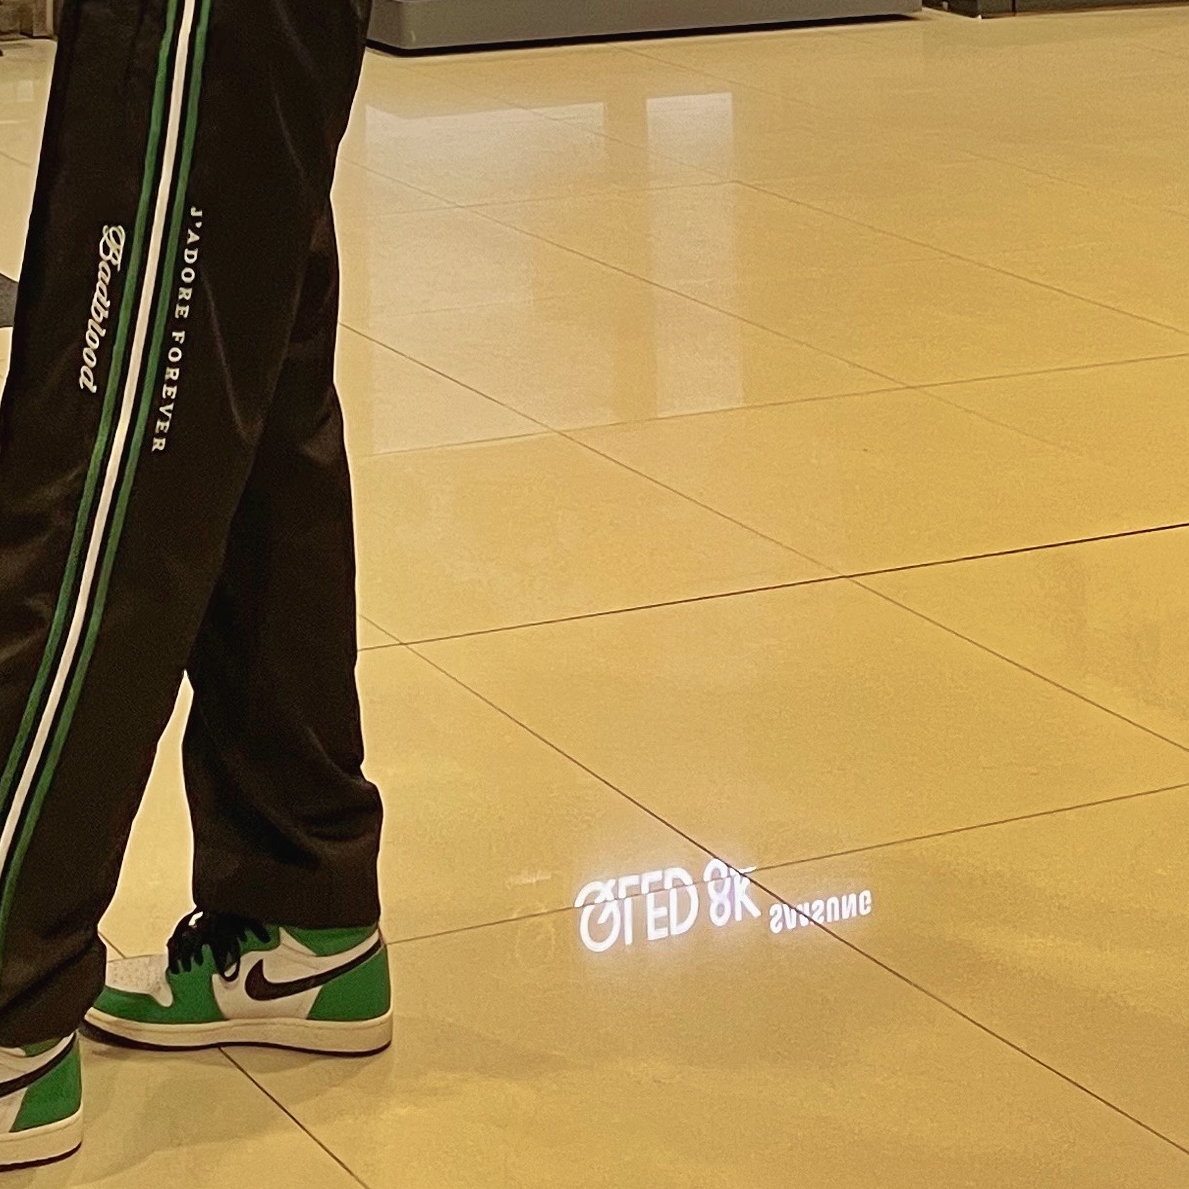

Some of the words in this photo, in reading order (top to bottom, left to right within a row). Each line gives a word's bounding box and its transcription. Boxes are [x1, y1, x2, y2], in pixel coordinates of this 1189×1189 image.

[79, 224, 126, 393] Badblood
[175, 207, 203, 319] J'ADORE
[151, 330, 186, 452] FOREVER
